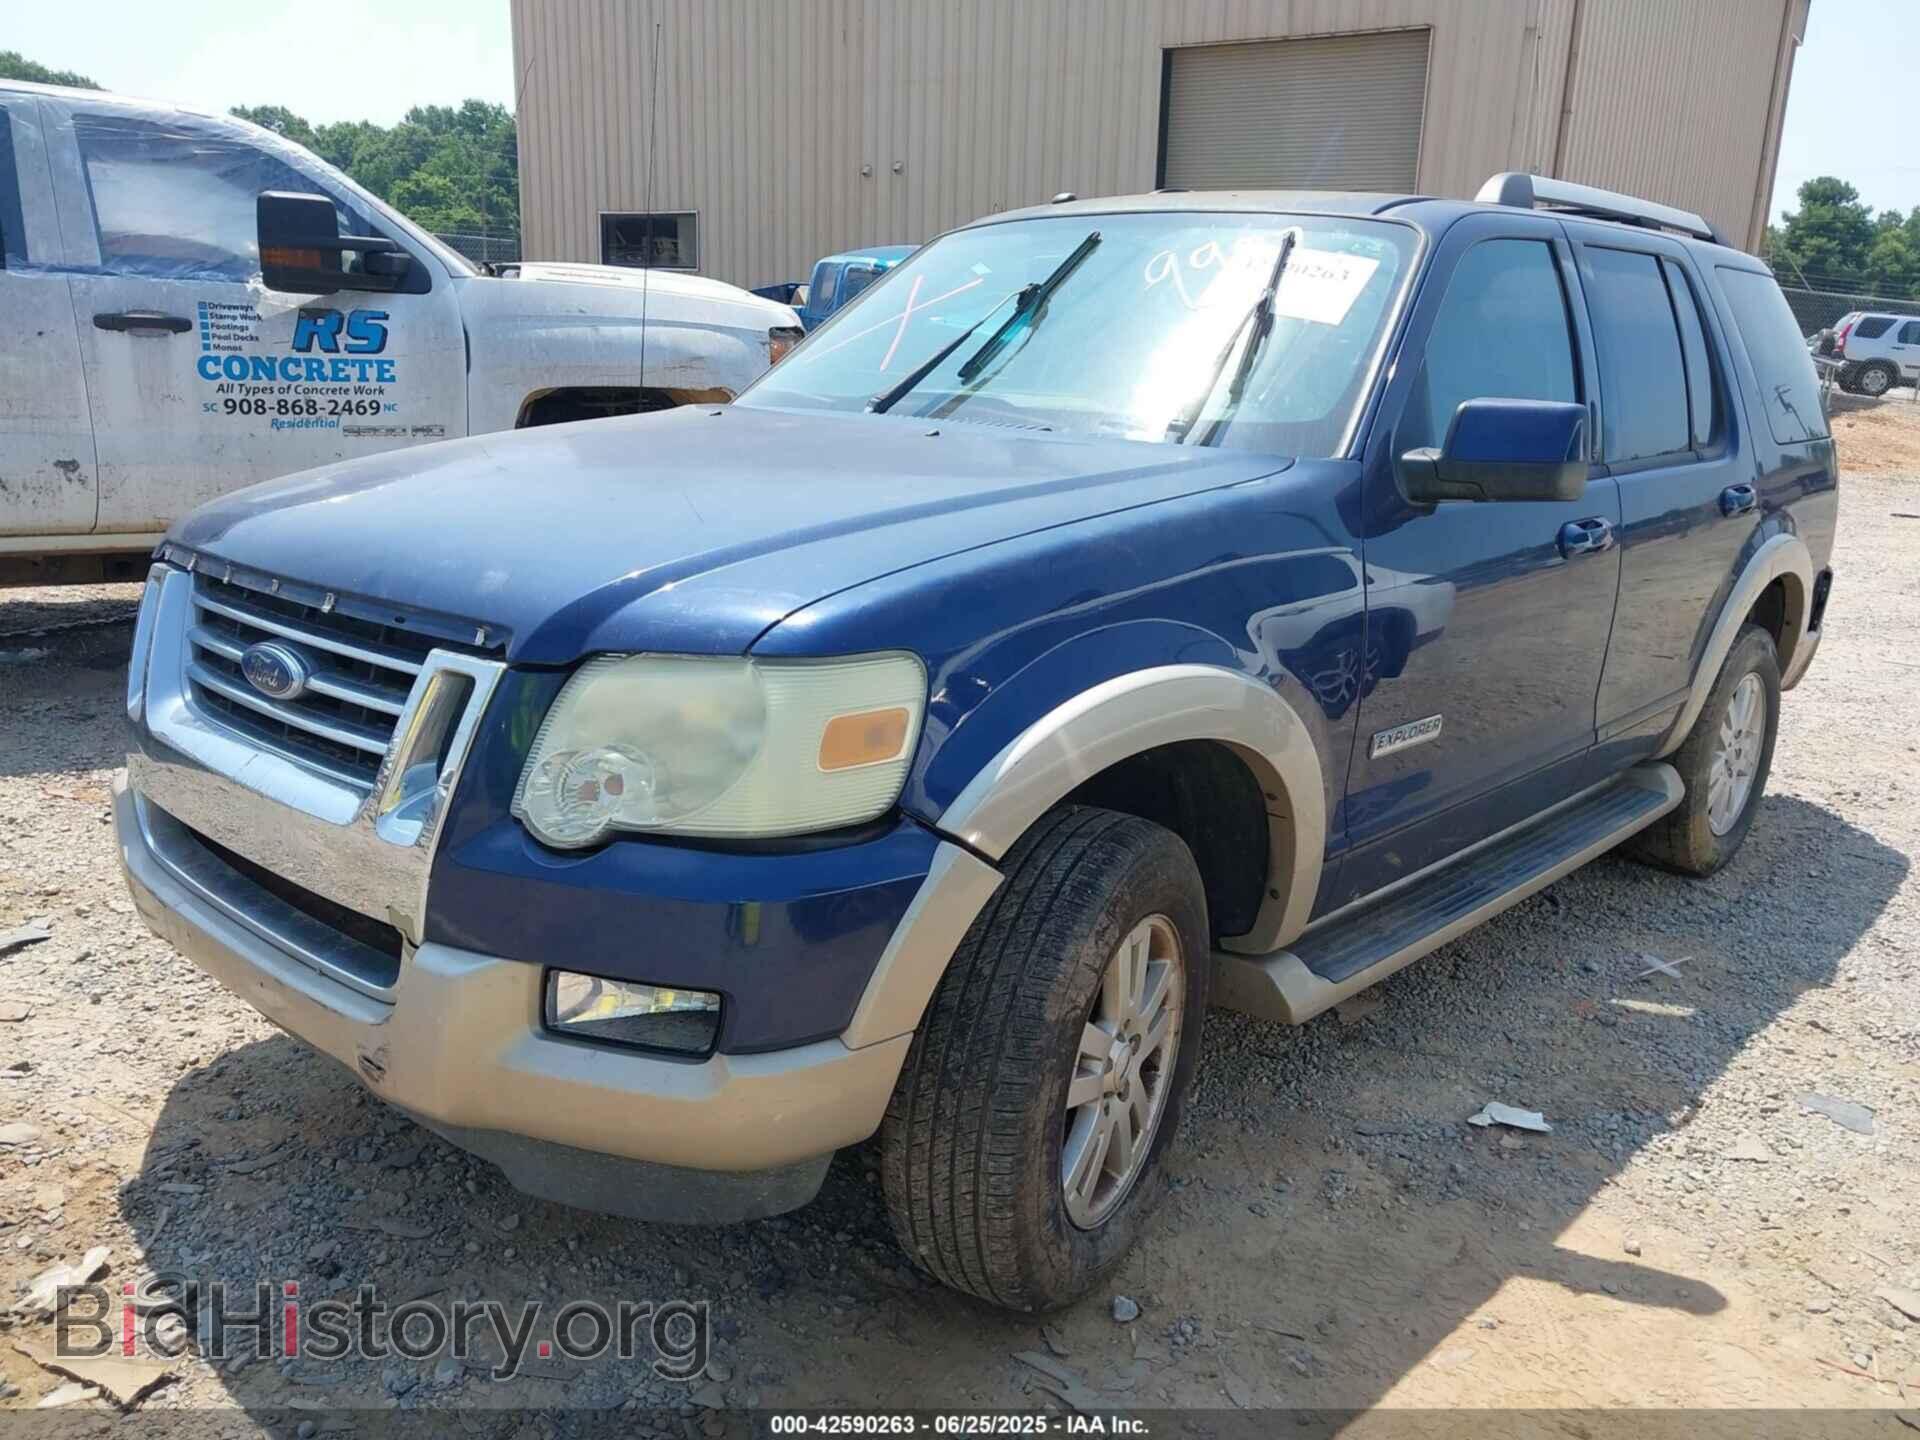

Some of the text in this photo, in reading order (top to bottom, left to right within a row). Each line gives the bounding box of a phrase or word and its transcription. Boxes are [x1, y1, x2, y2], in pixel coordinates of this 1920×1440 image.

[209, 312, 238, 321] Stamp
[211, 322, 249, 332] Footings
[291, 308, 389, 354] RS
[233, 334, 260, 342] Decks
[197, 355, 396, 383] CONCRETE
[216, 383, 385, 397] All Types of Concrete Work
[202, 398, 398, 416] SC 908-868-2469 NC
[271, 416, 340, 431] Residential
[1375, 718, 1441, 750] EXPLORER
